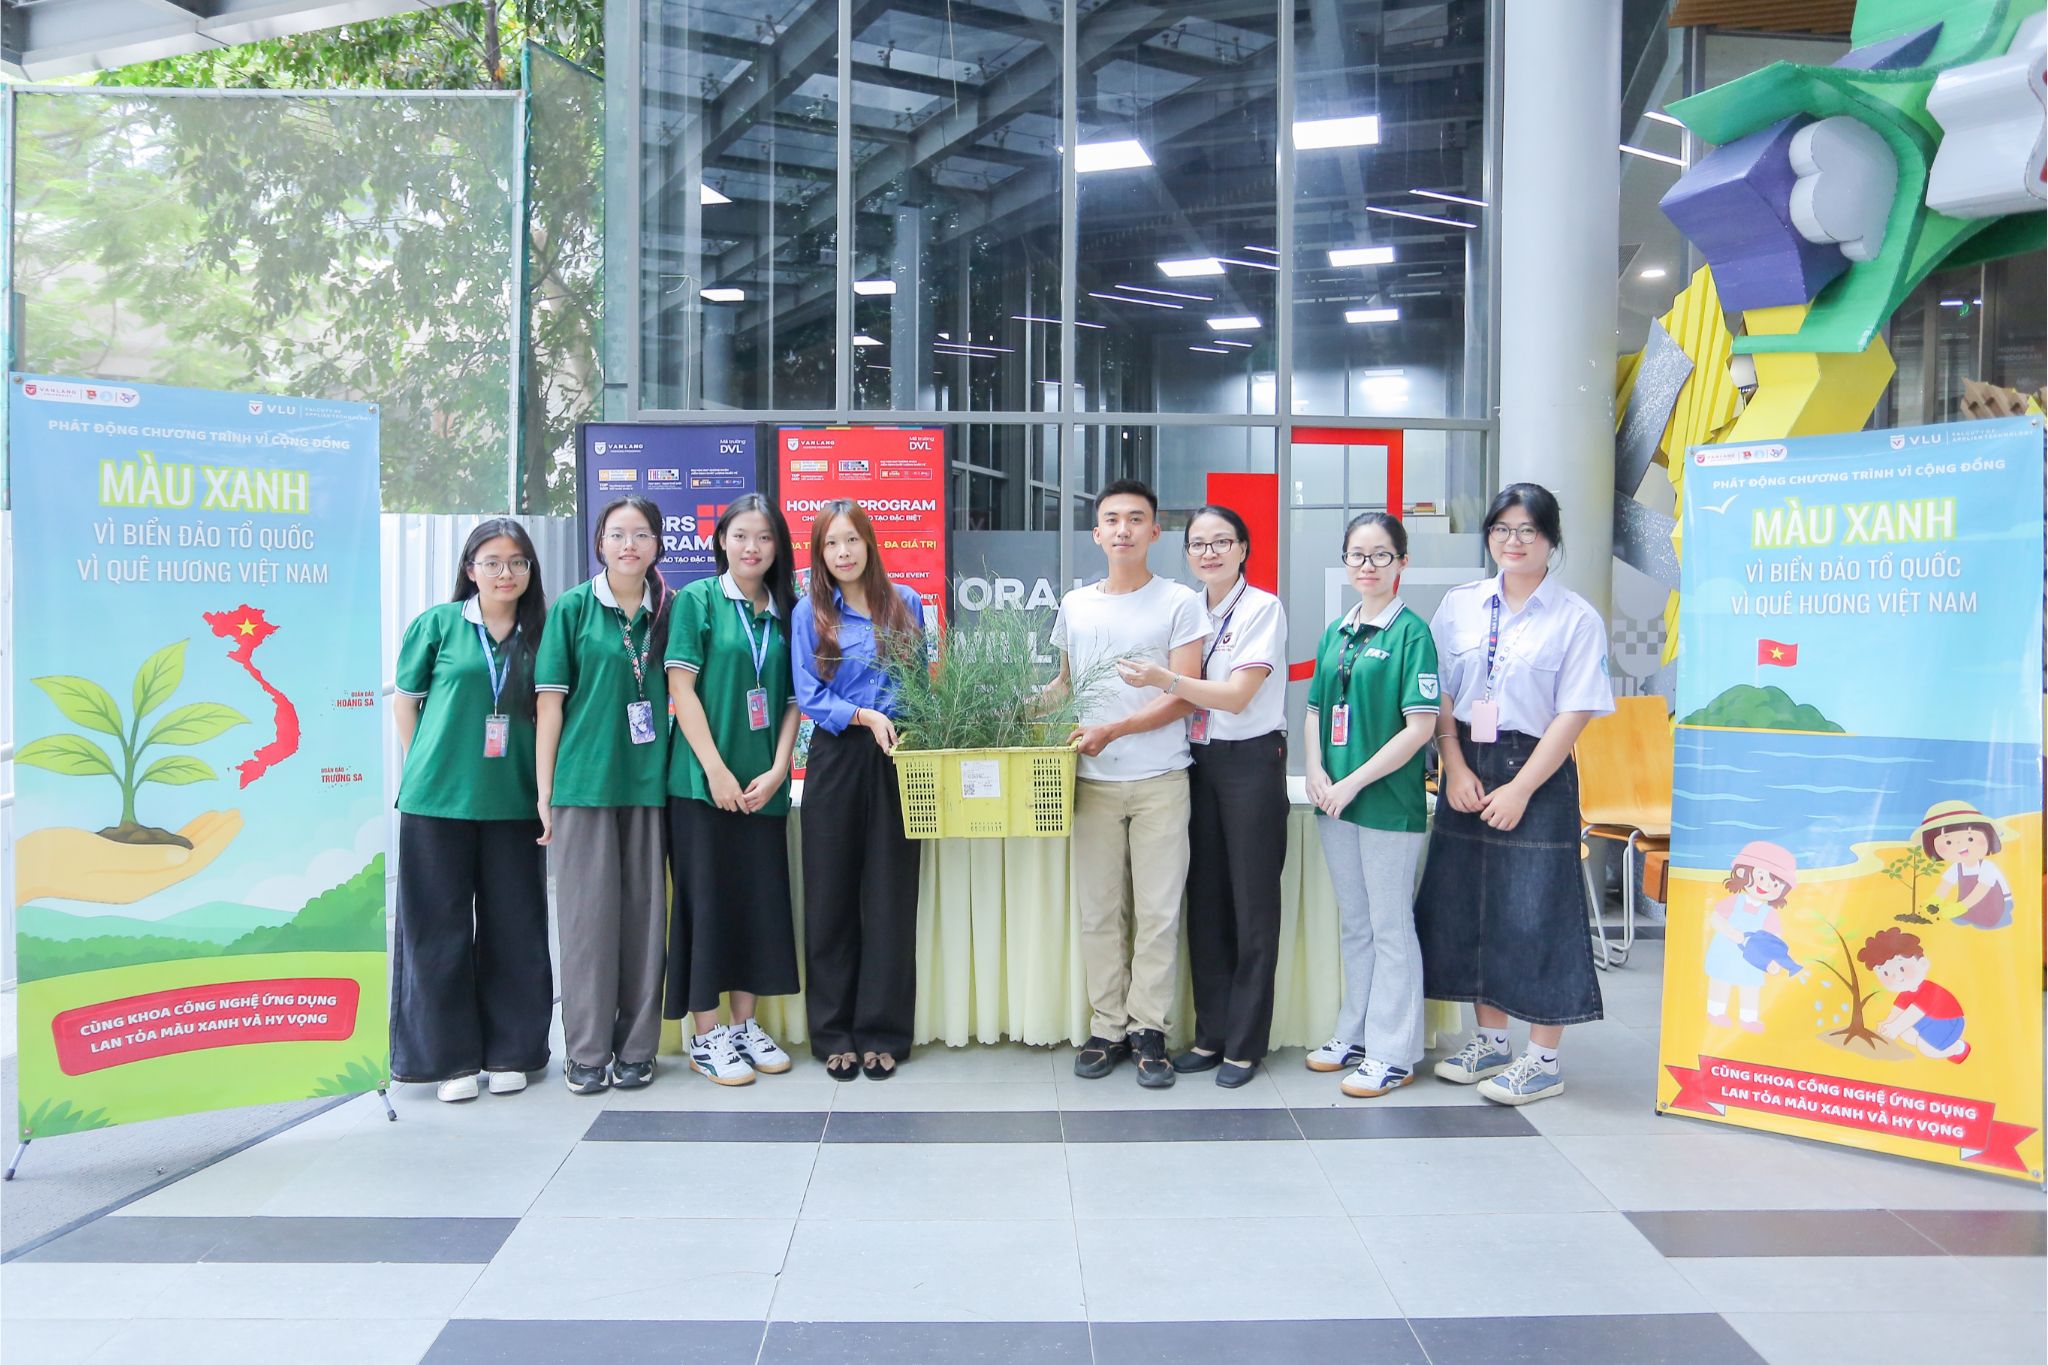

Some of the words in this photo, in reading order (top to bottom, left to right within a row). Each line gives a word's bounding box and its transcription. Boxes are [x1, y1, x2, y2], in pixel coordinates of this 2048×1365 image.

[266, 404, 296, 415] VLU
[48, 418, 91, 433] PHÁT
[94, 421, 138, 438] ĐỘNG
[142, 424, 206, 441] CHƯƠNG
[210, 426, 251, 444] TRÌNH
[255, 429, 268, 445] VÌ
[271, 430, 309, 449] CỘNG
[312, 433, 350, 450] ĐỒNG
[909, 442, 932, 450] DVL
[1909, 433, 1941, 445] VLU
[720, 445, 744, 454] DVL
[102, 454, 190, 506] MÀU
[205, 468, 307, 511] XANH
[1713, 475, 1746, 489] PHÁT
[1749, 473, 1786, 489] ĐỘNG
[1789, 470, 1849, 486] CHƯƠNG
[1852, 466, 1894, 481] TRÌNH
[1897, 463, 1912, 477] VÌ
[1915, 461, 1957, 477] CỘNG
[1960, 457, 2006, 473] ĐỒNG
[662, 516, 696, 532] RS
[889, 514, 904, 522] ĐẶC
[906, 513, 922, 522] BIỆT
[1754, 500, 1832, 547] MÀU
[1847, 499, 1953, 543] XANH
[94, 519, 114, 545] VÌ
[123, 517, 171, 546] BIỂN
[178, 520, 220, 548] ĐẢO
[228, 520, 251, 549] TỔ
[260, 522, 314, 552] QUỐC
[663, 535, 714, 551] RAM
[901, 539, 918, 548] GIÁ
[920, 541, 937, 550] TRỊ
[77, 556, 99, 581] VÌ
[107, 554, 150, 584] QUÊ
[158, 558, 231, 584] HƯƠNG
[238, 559, 279, 588] VIỆT
[286, 562, 328, 585] NAM
[674, 556, 688, 564] TẠO
[690, 555, 706, 564] ĐẶC
[1746, 558, 1763, 583] VÌ
[1770, 555, 1813, 583] BIỂN
[1819, 556, 1860, 581] ĐẢO
[1867, 552, 1893, 580] TỔ
[1900, 551, 1961, 580] QUỐC
[1731, 591, 1748, 615] VÌ
[1755, 591, 1794, 616] QUÊ
[1800, 592, 1870, 614] HƯƠNG
[1877, 588, 1921, 615] VIỆT
[1929, 591, 1977, 613] NAM
[364, 698, 374, 707] SA
[321, 772, 351, 783] TRƯỜNG
[353, 773, 362, 782] SA
[80, 1016, 124, 1037] CÙNG
[127, 1007, 171, 1025] KHOA
[174, 998, 216, 1016] CÔNG
[219, 995, 260, 1010] NGHỆ
[262, 993, 294, 1007] ỨNG
[297, 995, 337, 1010] DỤNG
[90, 1036, 122, 1054] LAN
[125, 1027, 157, 1046] TỎA
[160, 1020, 195, 1038] MÀU
[198, 1017, 239, 1034] XANH
[242, 1012, 261, 1027] VÀ
[265, 1014, 284, 1027] HY
[287, 1013, 328, 1028] VỌNG
[1711, 1064, 1750, 1082] CÙNG
[1753, 1072, 1795, 1089] KHOA
[1797, 1078, 1840, 1097] CÔNG
[1843, 1088, 1886, 1107] NGHỆ
[1889, 1092, 1926, 1111] ỨNG
[1928, 1103, 1977, 1121] DỤNG
[1721, 1085, 1749, 1101] LAN
[1751, 1089, 1781, 1107] TỎA
[1784, 1095, 1818, 1113] MÀU
[1821, 1103, 1863, 1121] XANH
[1867, 1108, 1889, 1124] VÀ
[1892, 1114, 1914, 1128] HY
[1917, 1120, 1965, 1139] VỌNG
